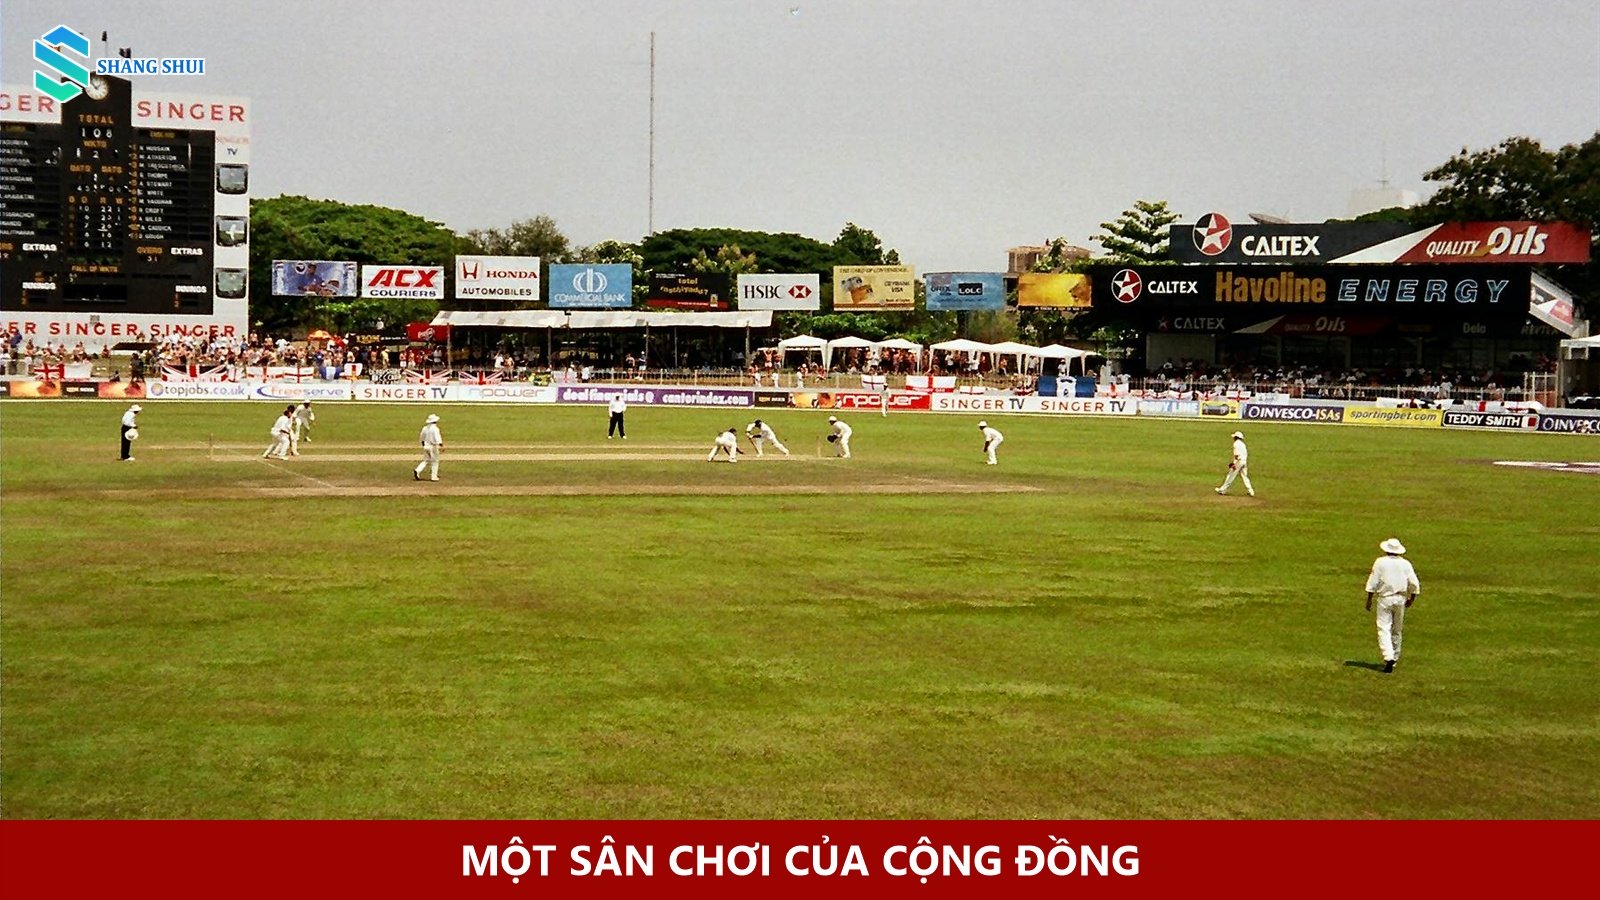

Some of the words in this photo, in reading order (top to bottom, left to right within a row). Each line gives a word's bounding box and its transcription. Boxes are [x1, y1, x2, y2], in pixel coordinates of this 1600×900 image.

[137, 100, 245, 122] SINGER
[79, 114, 114, 124] TOTAL
[227, 148, 237, 156] TV
[22, 243, 58, 252] EXTRAS
[1240, 235, 1321, 257] CALTEX
[1426, 240, 1481, 258] QUALITY
[1487, 224, 1549, 256] Oils
[170, 247, 203, 256] EXTRAS
[368, 269, 439, 288] ACX
[486, 270, 538, 280] HONDA
[370, 289, 437, 298] COURIERS
[462, 287, 532, 296] AUTOMOBILES
[744, 284, 785, 299] HSBC
[960, 286, 982, 294] LOLC
[1148, 280, 1199, 294] CALTEX
[1215, 271, 1327, 304] Havoline
[1337, 278, 1510, 304] ENERGY
[602, 293, 626, 302] BANK
[0, 322, 37, 336] ER
[50, 322, 139, 336] SINGER
[150, 324, 236, 338] SINGER
[1174, 317, 1225, 330] CALTEX
[1315, 316, 1346, 332] Oils
[165, 384, 245, 396] topjobs.co.uk
[364, 388, 426, 399] SINGER
[431, 388, 448, 398] TV
[468, 388, 546, 398] npower
[563, 388, 588, 401] deal
[590, 388, 644, 402] finanials
[662, 391, 748, 406] cantorindex.com
[940, 398, 1004, 410] SINGER
[1009, 398, 1025, 410] TV
[1041, 400, 1104, 412] SINGER
[1109, 401, 1126, 412] TV
[1260, 406, 1340, 421] INVESCO-ISAs
[1350, 408, 1437, 422] sportingbet.com
[1448, 414, 1484, 426] TEDDY
[1486, 415, 1520, 427] SMITH
[1555, 418, 1600, 432] INVEC
